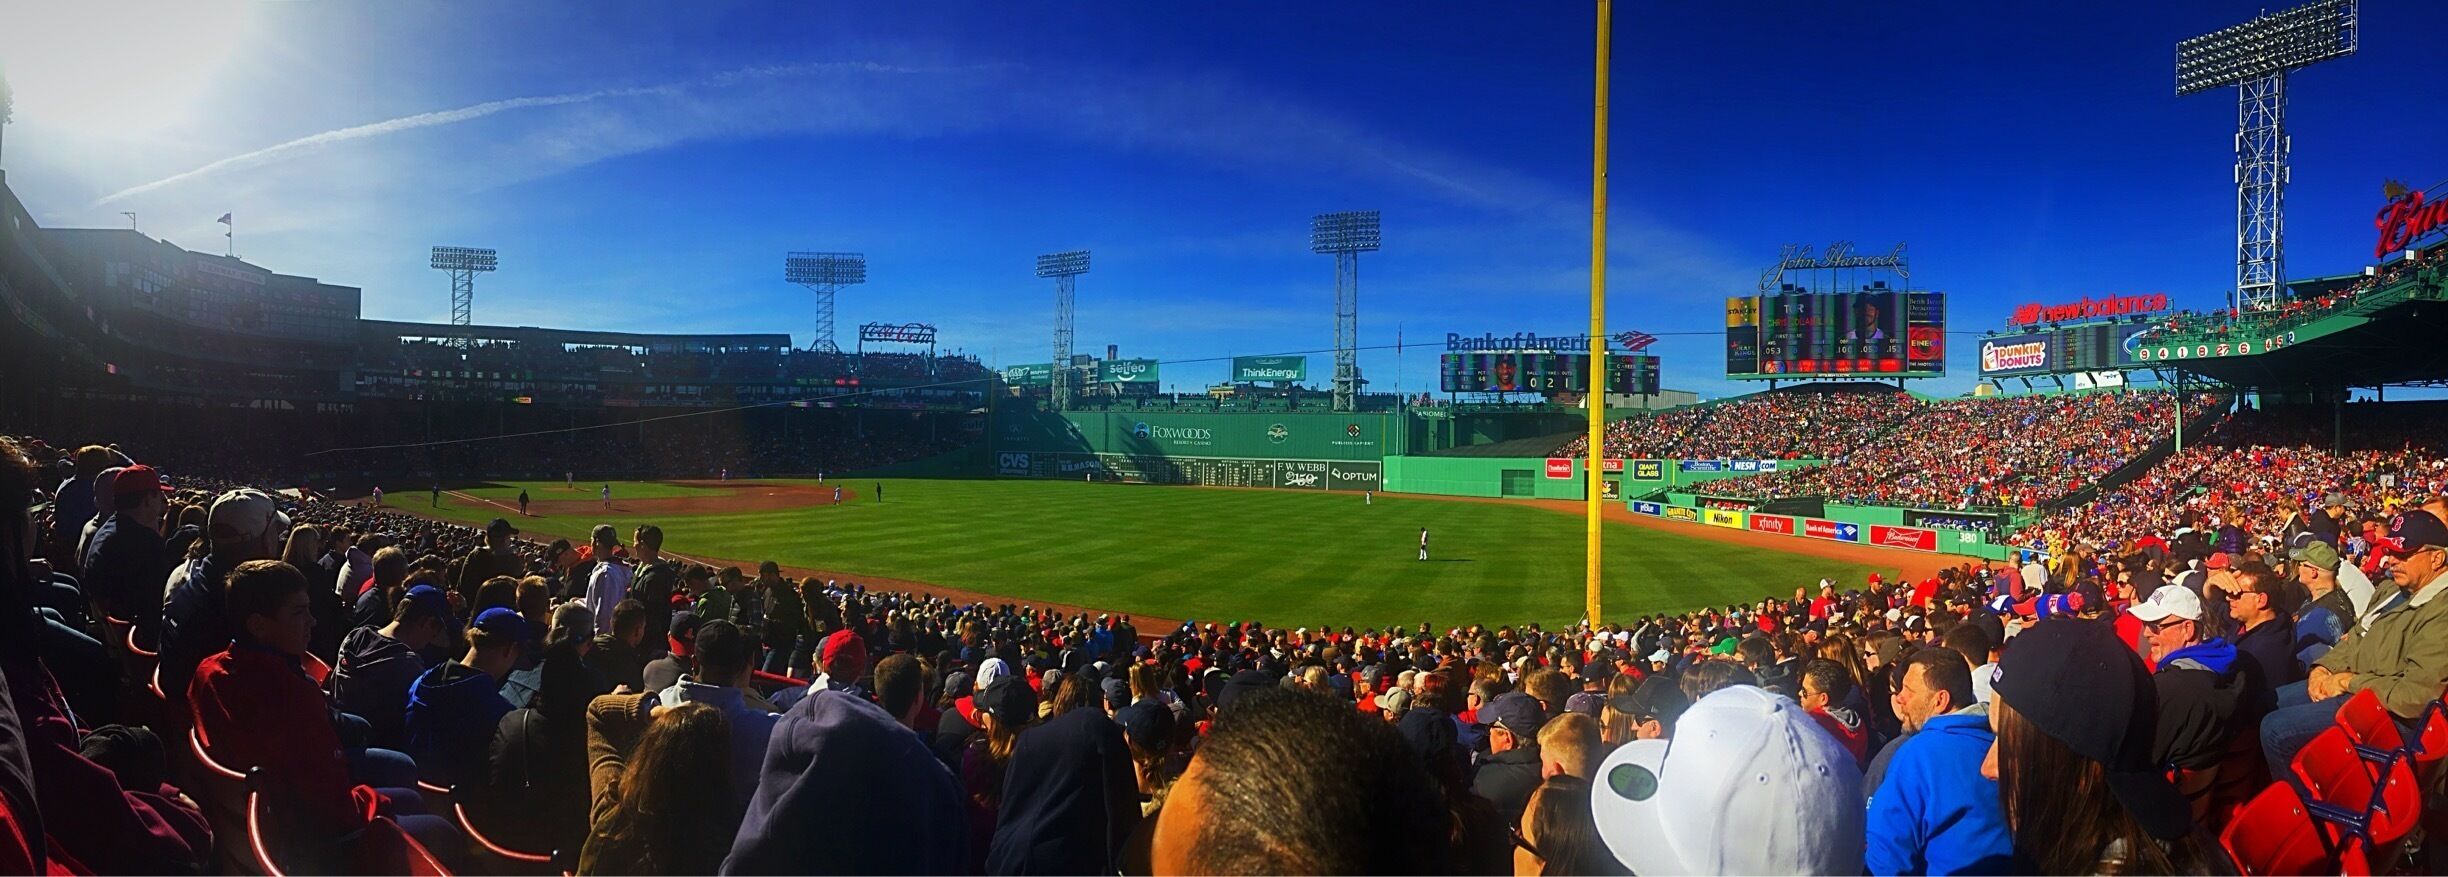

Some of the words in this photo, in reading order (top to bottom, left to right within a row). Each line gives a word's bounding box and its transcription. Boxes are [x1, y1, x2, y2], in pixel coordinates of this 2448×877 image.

[1759, 244, 1816, 291] John
[1816, 239, 1909, 278] Hancock
[1447, 332, 1498, 351] Bank
[1501, 332, 1522, 351] of
[1999, 343, 2045, 357] DUNKIN'
[2159, 349, 2168, 358] 4
[2198, 347, 2206, 356] 8
[2216, 345, 2230, 356] 27
[2240, 344, 2248, 353] 6
[2141, 350, 2149, 360] 9
[1999, 355, 2042, 368] DONUTS
[1530, 378, 1537, 388] 0
[1547, 378, 1554, 388] 2
[1152, 425, 1211, 439] FOXWOODS
[999, 452, 1030, 469] CVS
[1277, 462, 1285, 471] F.
[1285, 462, 1295, 472] W.
[1297, 462, 1326, 472] WEBB
[1342, 472, 1377, 481] OPTUM
[1686, 508, 1697, 519] CITY
[1713, 513, 1733, 524] Nikon
[1758, 517, 1783, 533] xfinity
[1805, 523, 1817, 531] Bank
[1823, 525, 1843, 535] America
[1887, 531, 1920, 543] Budweiser
[1959, 532, 1977, 544] 380
